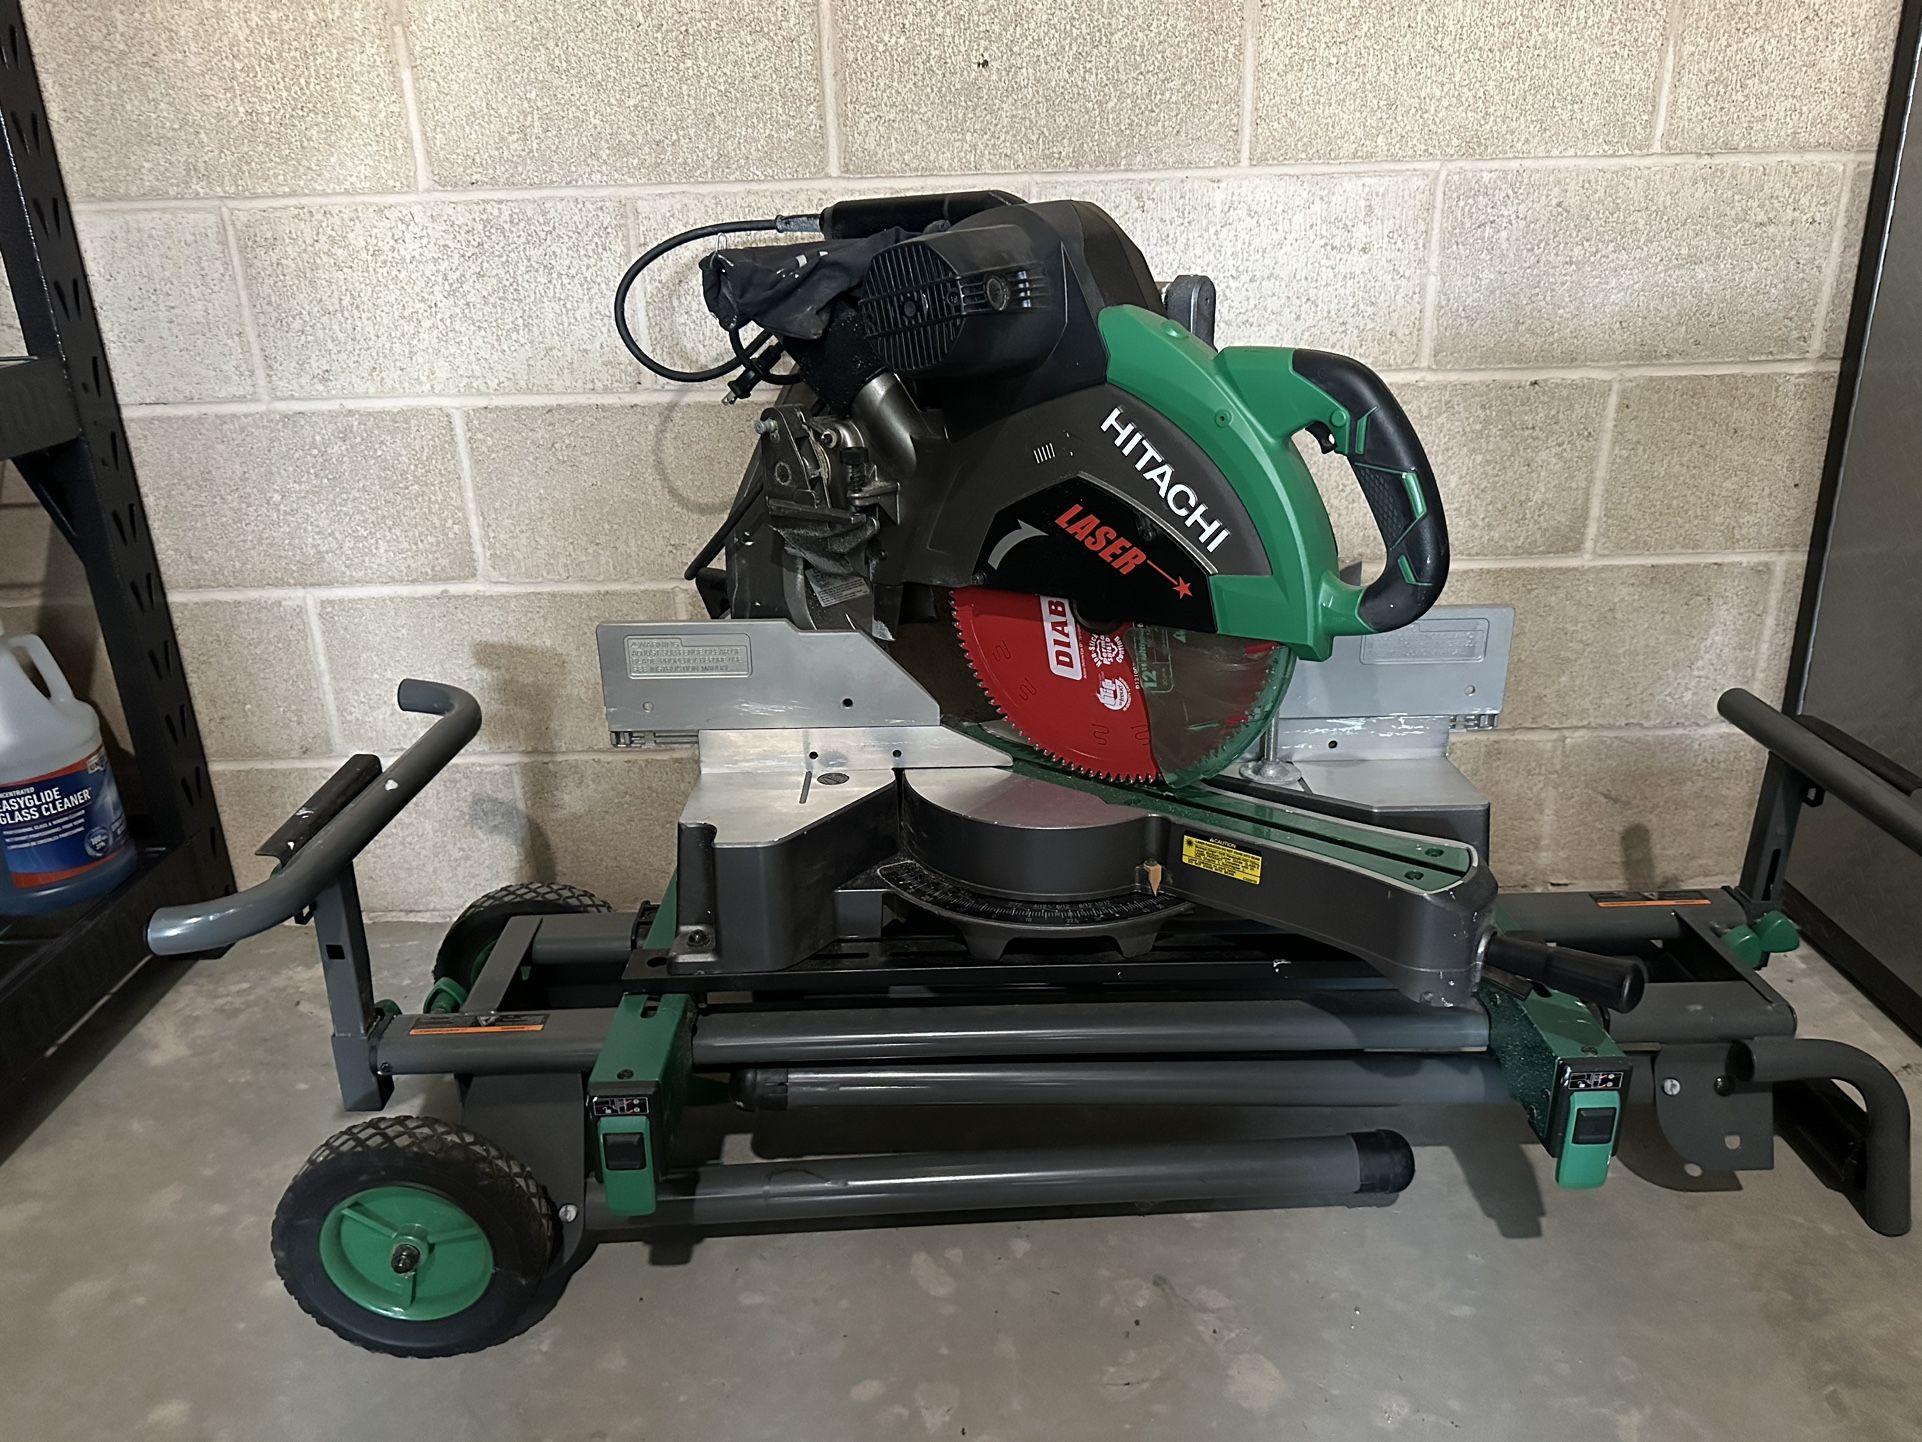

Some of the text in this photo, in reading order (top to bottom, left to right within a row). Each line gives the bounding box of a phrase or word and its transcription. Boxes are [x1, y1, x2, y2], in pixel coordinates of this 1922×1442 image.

[1100, 406, 1231, 553] HITACHI
[1054, 503, 1147, 575] LASER
[1047, 599, 1074, 670] DIAB
[0, 807, 40, 825] GLASS
[41, 788, 92, 816] CLEANER
[1214, 838, 1237, 849] CAUTION
